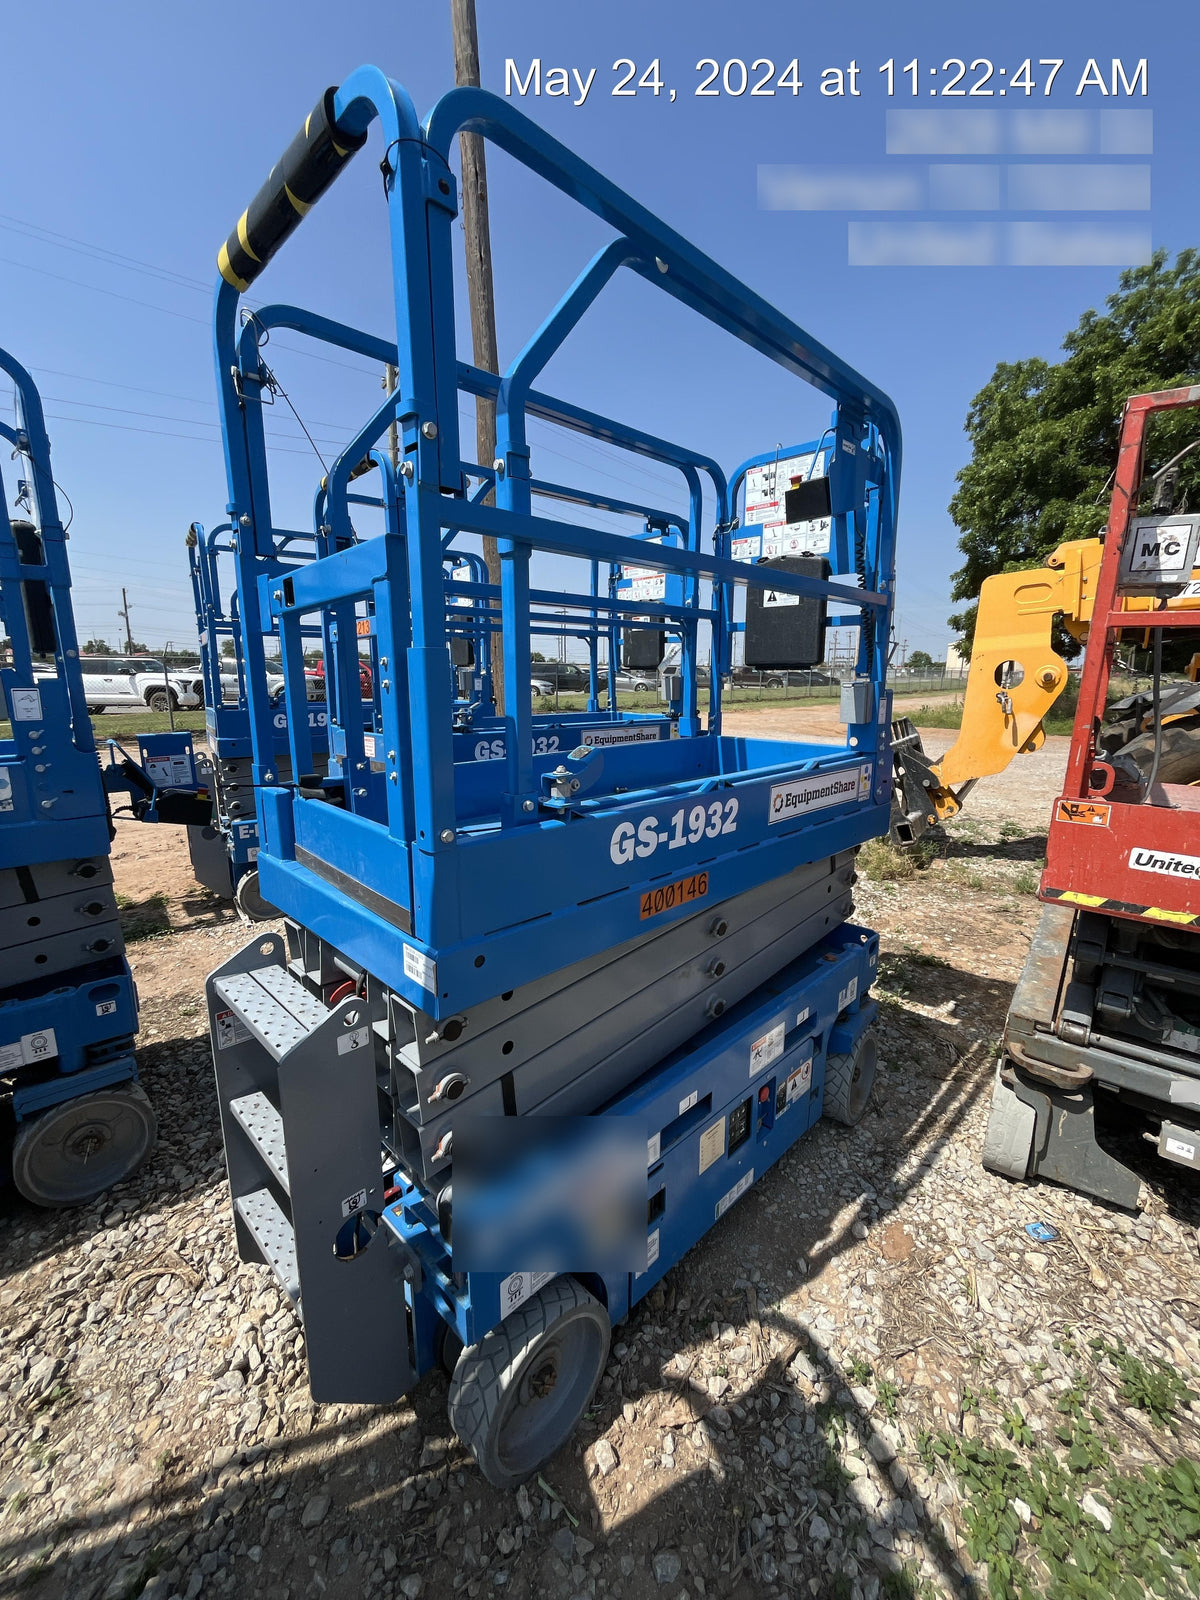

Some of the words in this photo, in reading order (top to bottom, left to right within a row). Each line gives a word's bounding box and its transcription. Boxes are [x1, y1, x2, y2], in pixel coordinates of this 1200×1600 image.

[1141, 541, 1181, 557] MC
[594, 732, 657, 745] EquipmentShare
[784, 780, 856, 808] EquipmentShare
[609, 797, 739, 865] GS-1932
[642, 872, 707, 916] 400146
